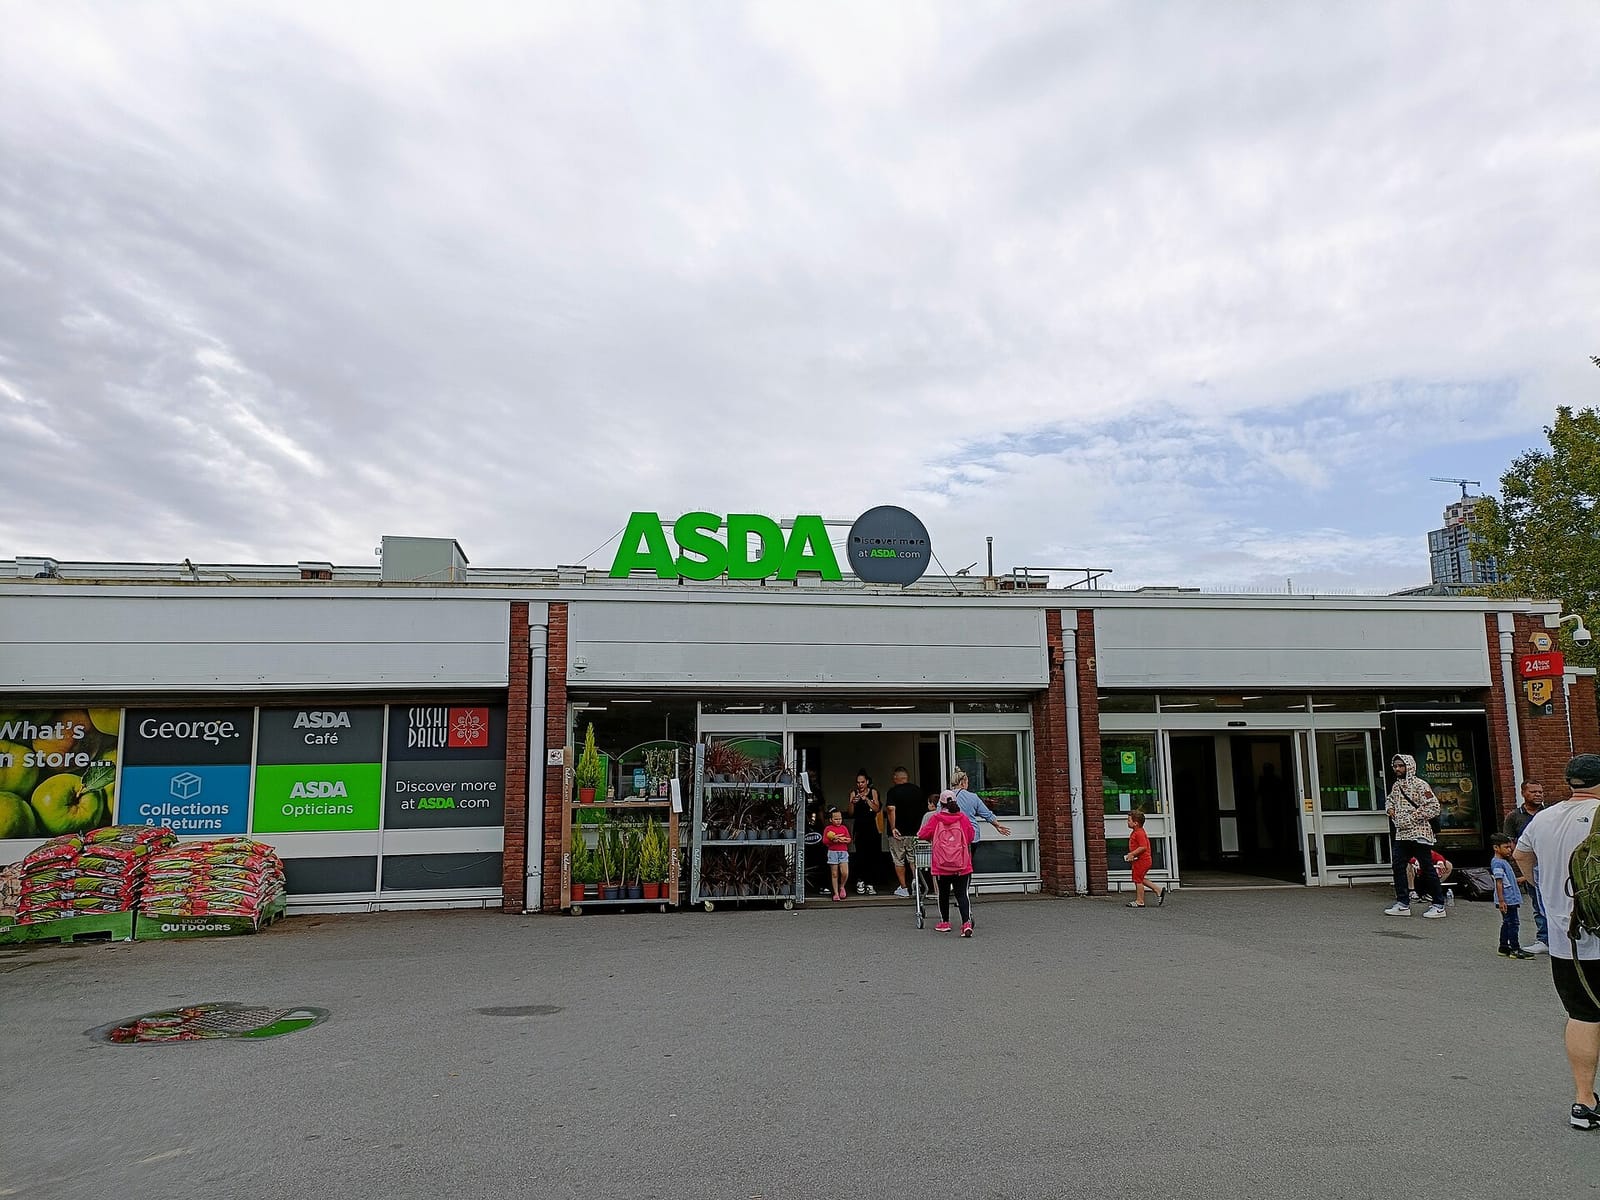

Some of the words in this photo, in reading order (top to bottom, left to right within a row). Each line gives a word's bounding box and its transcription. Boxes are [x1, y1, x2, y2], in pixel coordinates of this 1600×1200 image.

[608, 511, 843, 582] ASDA
[854, 536, 896, 546] Discover
[899, 538, 925, 546] more
[858, 549, 868, 558] at
[1525, 659, 1539, 672] 24
[293, 711, 351, 729] ASDA
[408, 707, 448, 728] SUSHI
[139, 718, 240, 746] George.
[304, 732, 338, 745] Café
[408, 727, 448, 748] DAILY
[1425, 733, 1458, 749] WIN
[23, 750, 111, 767] store...
[1426, 751, 1434, 761] A
[1436, 748, 1463, 763] BIG
[289, 781, 347, 799] ASDA
[395, 781, 456, 793] Discover
[461, 781, 497, 792] more
[139, 803, 229, 816] Collections
[281, 803, 353, 817] Opticians
[401, 799, 415, 810] at
[161, 817, 222, 829] Returns
[160, 923, 231, 932] OUTDOORS
